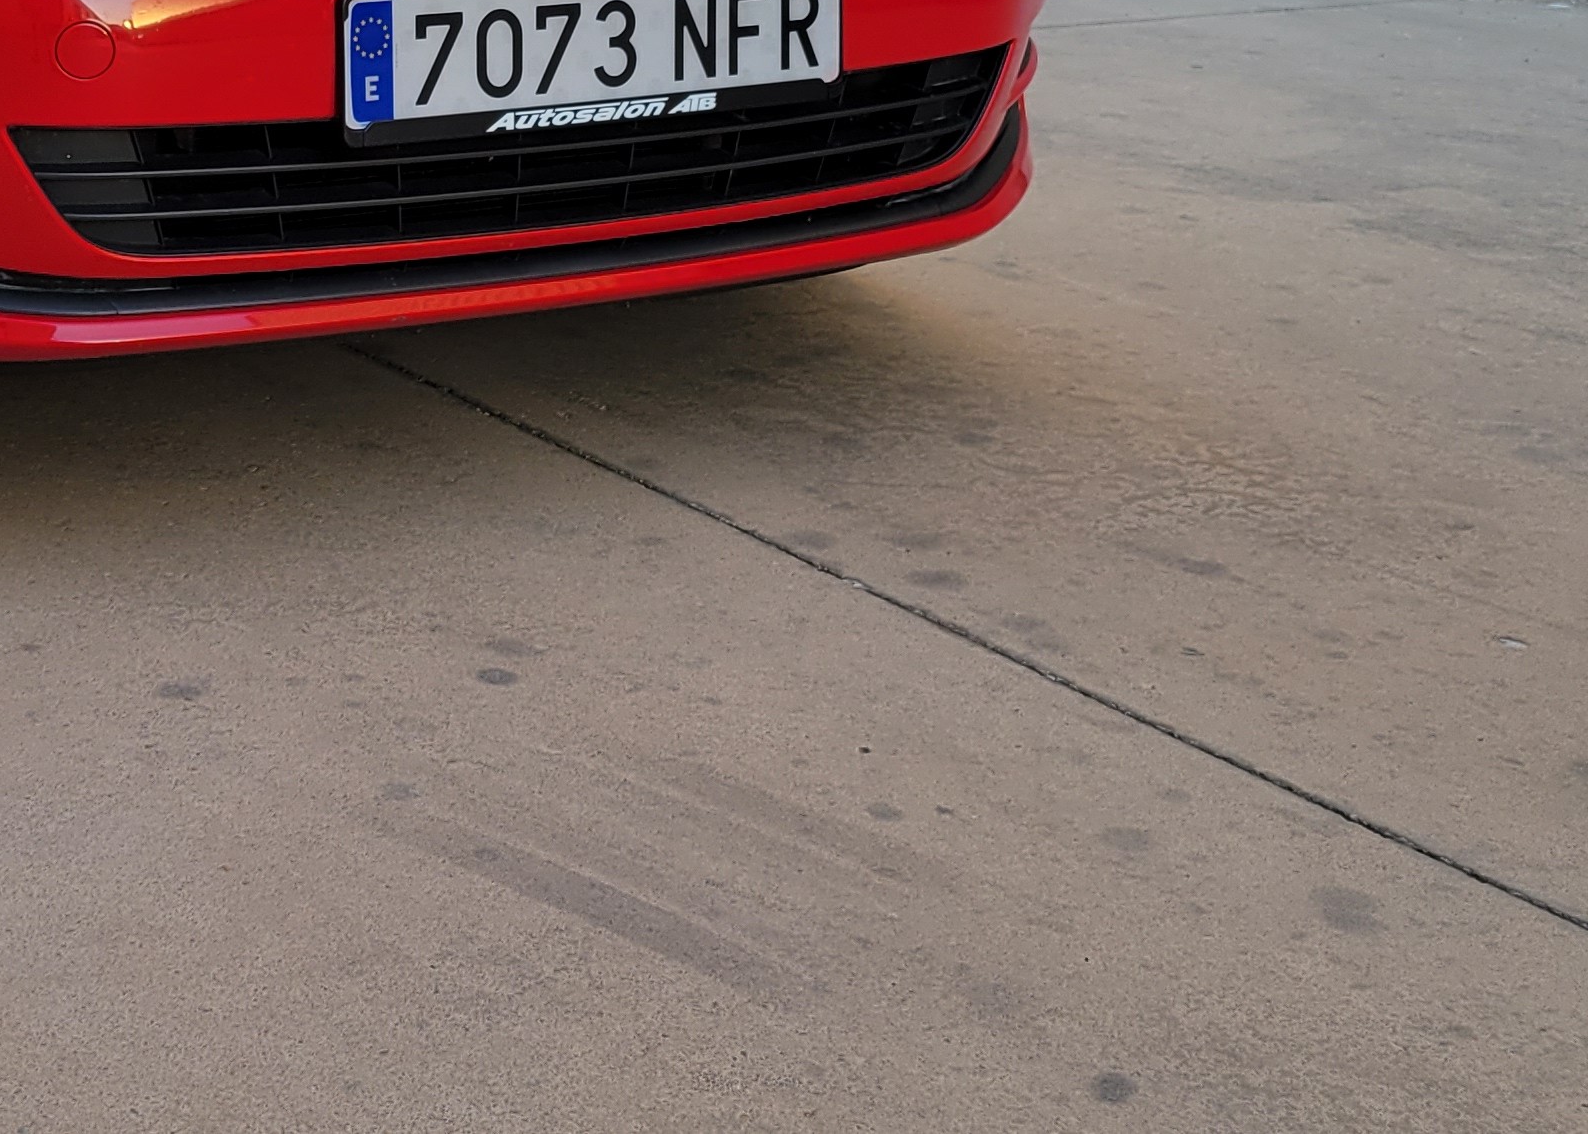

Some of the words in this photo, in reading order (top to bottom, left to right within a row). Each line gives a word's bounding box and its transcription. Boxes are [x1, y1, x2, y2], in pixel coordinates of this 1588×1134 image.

[415, 0, 638, 106] 7073
[364, 74, 380, 102] E
[485, 97, 670, 133] Autosalon
